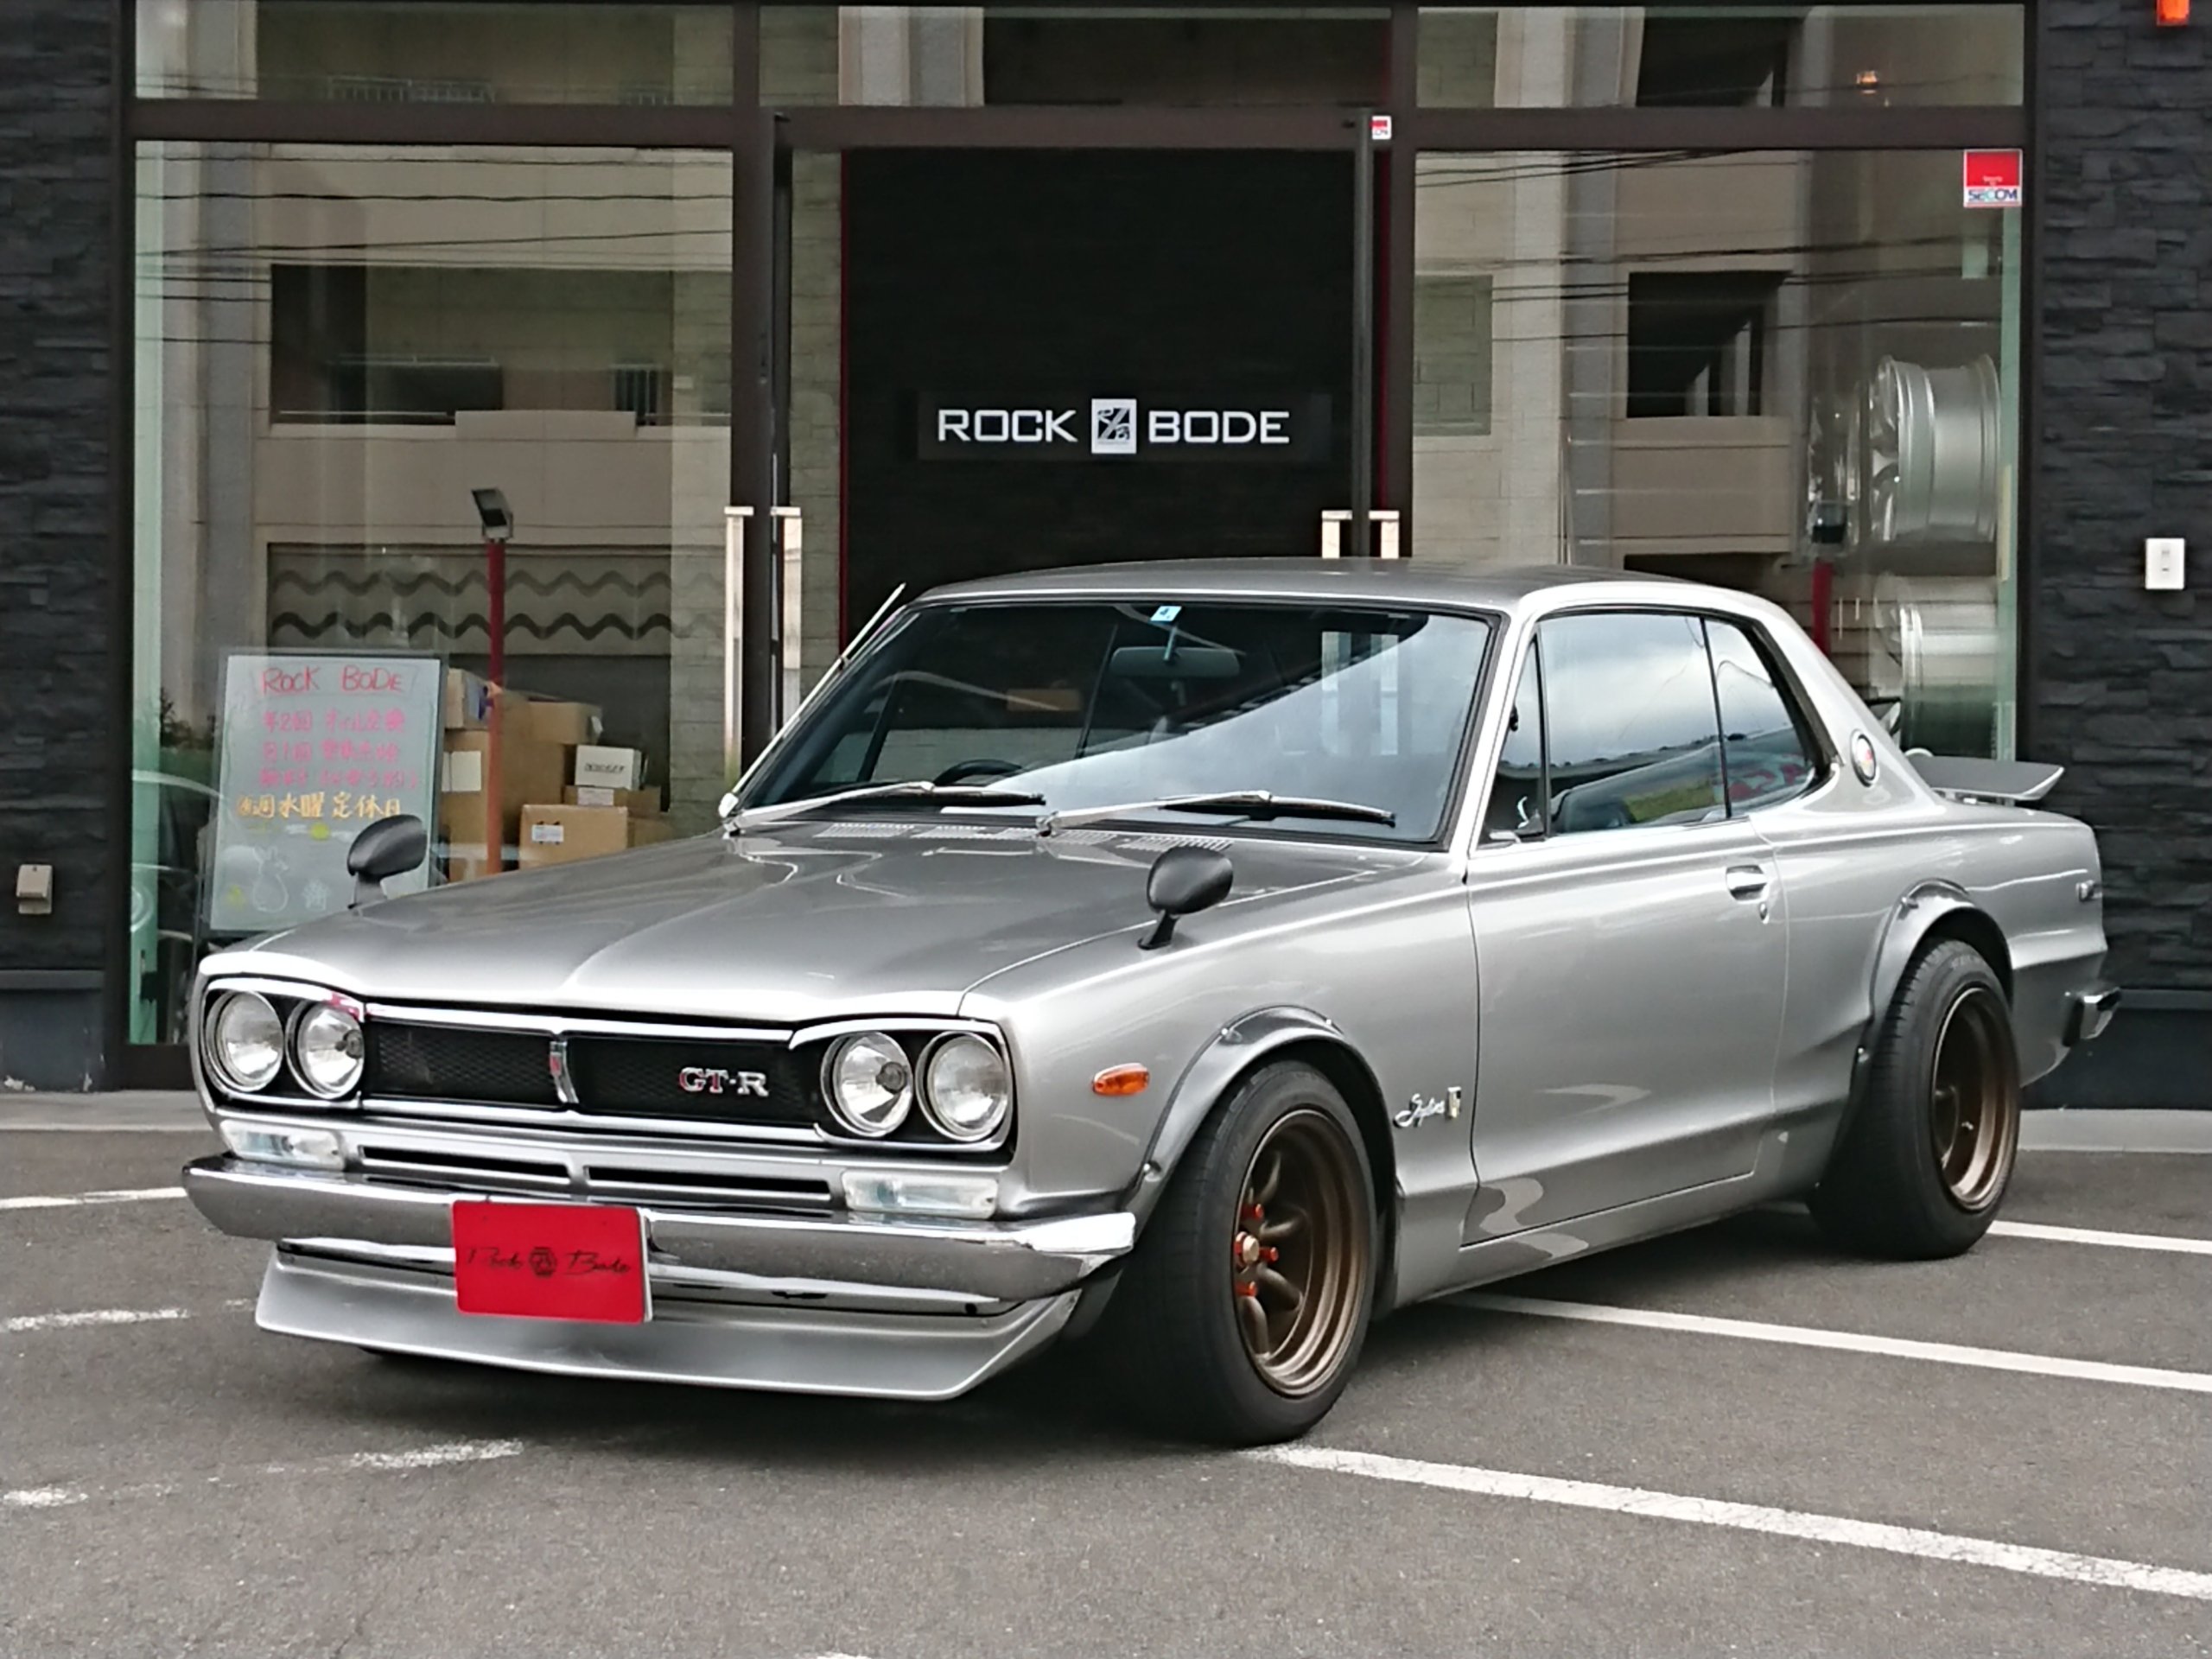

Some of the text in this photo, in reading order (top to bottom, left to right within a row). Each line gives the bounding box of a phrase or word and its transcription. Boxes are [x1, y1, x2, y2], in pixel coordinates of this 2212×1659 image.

[938, 409, 1290, 444] ROCK BODE
[679, 1066, 769, 1097] GT-R
